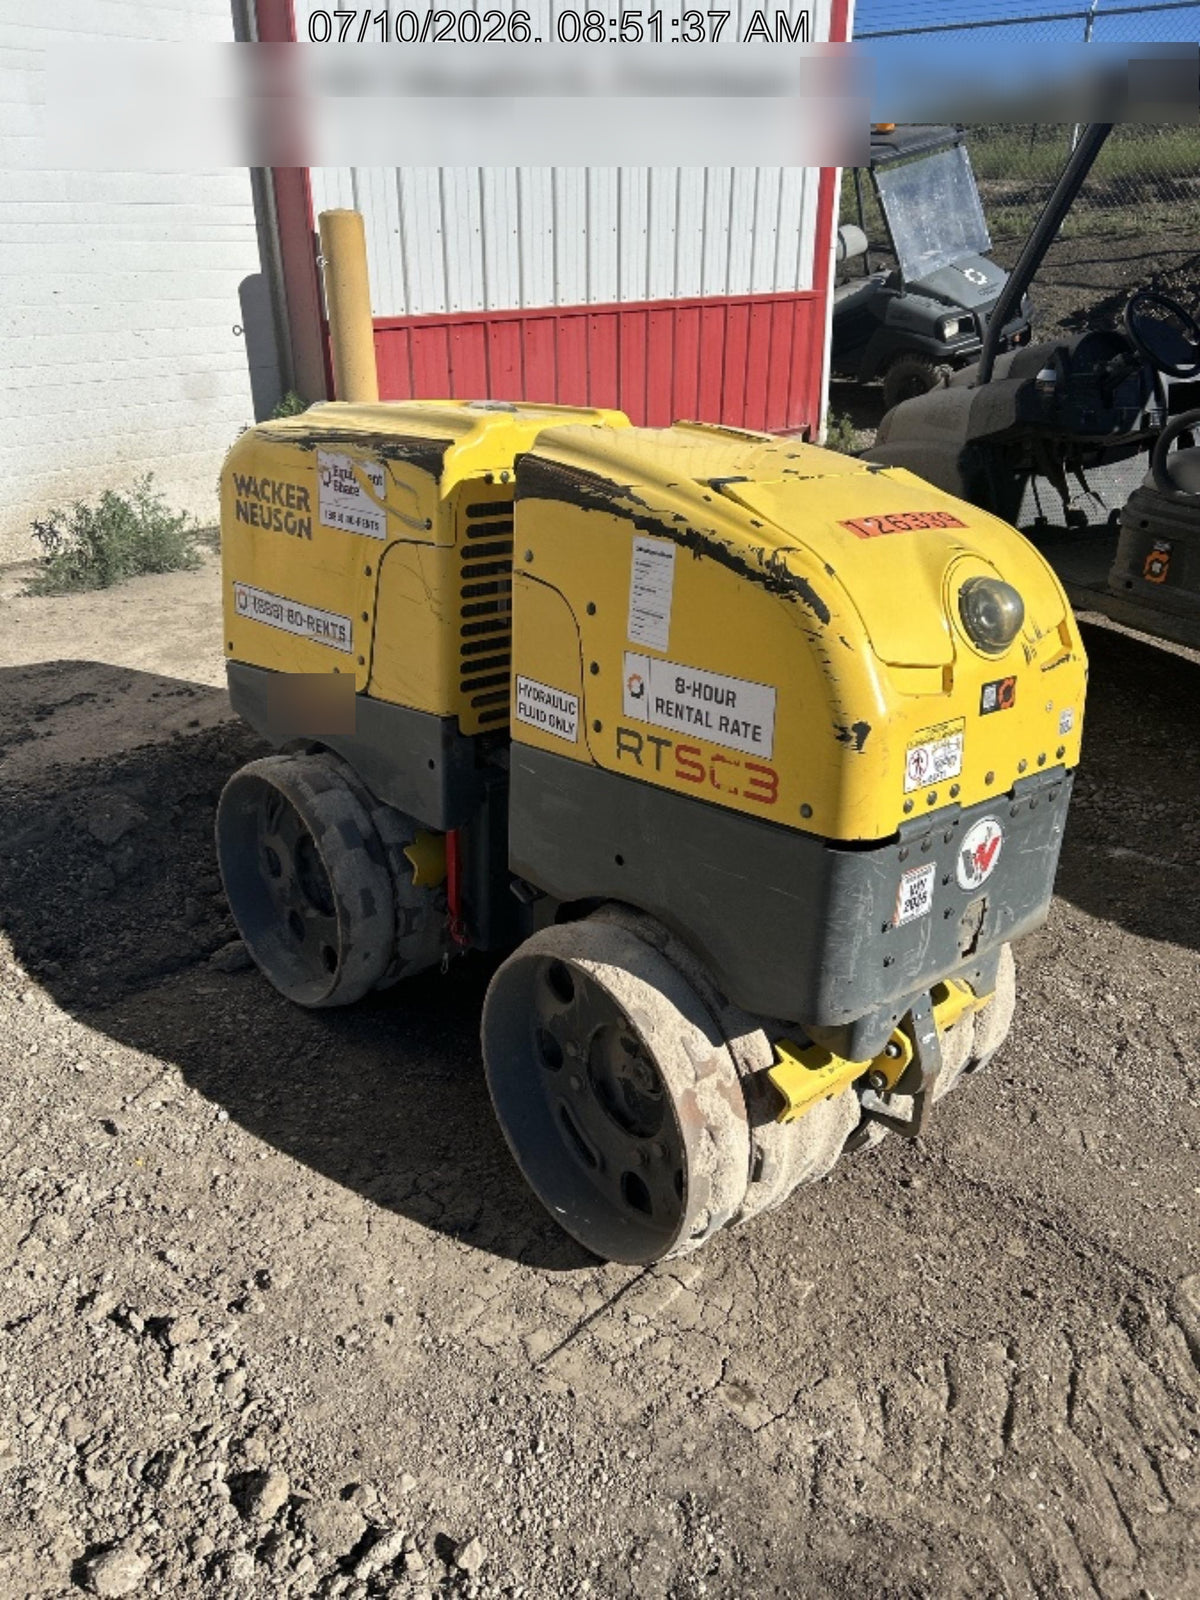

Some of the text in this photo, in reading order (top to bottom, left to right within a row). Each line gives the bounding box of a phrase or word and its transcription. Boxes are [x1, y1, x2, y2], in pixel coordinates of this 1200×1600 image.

[233, 472, 311, 513] WACKER
[235, 499, 313, 541] NEUSON
[518, 682, 577, 716] HYDRAULIC
[675, 676, 737, 708] 8-HOUR
[518, 701, 575, 735] FLUID ONLY
[655, 697, 762, 743] RENTAL RATE
